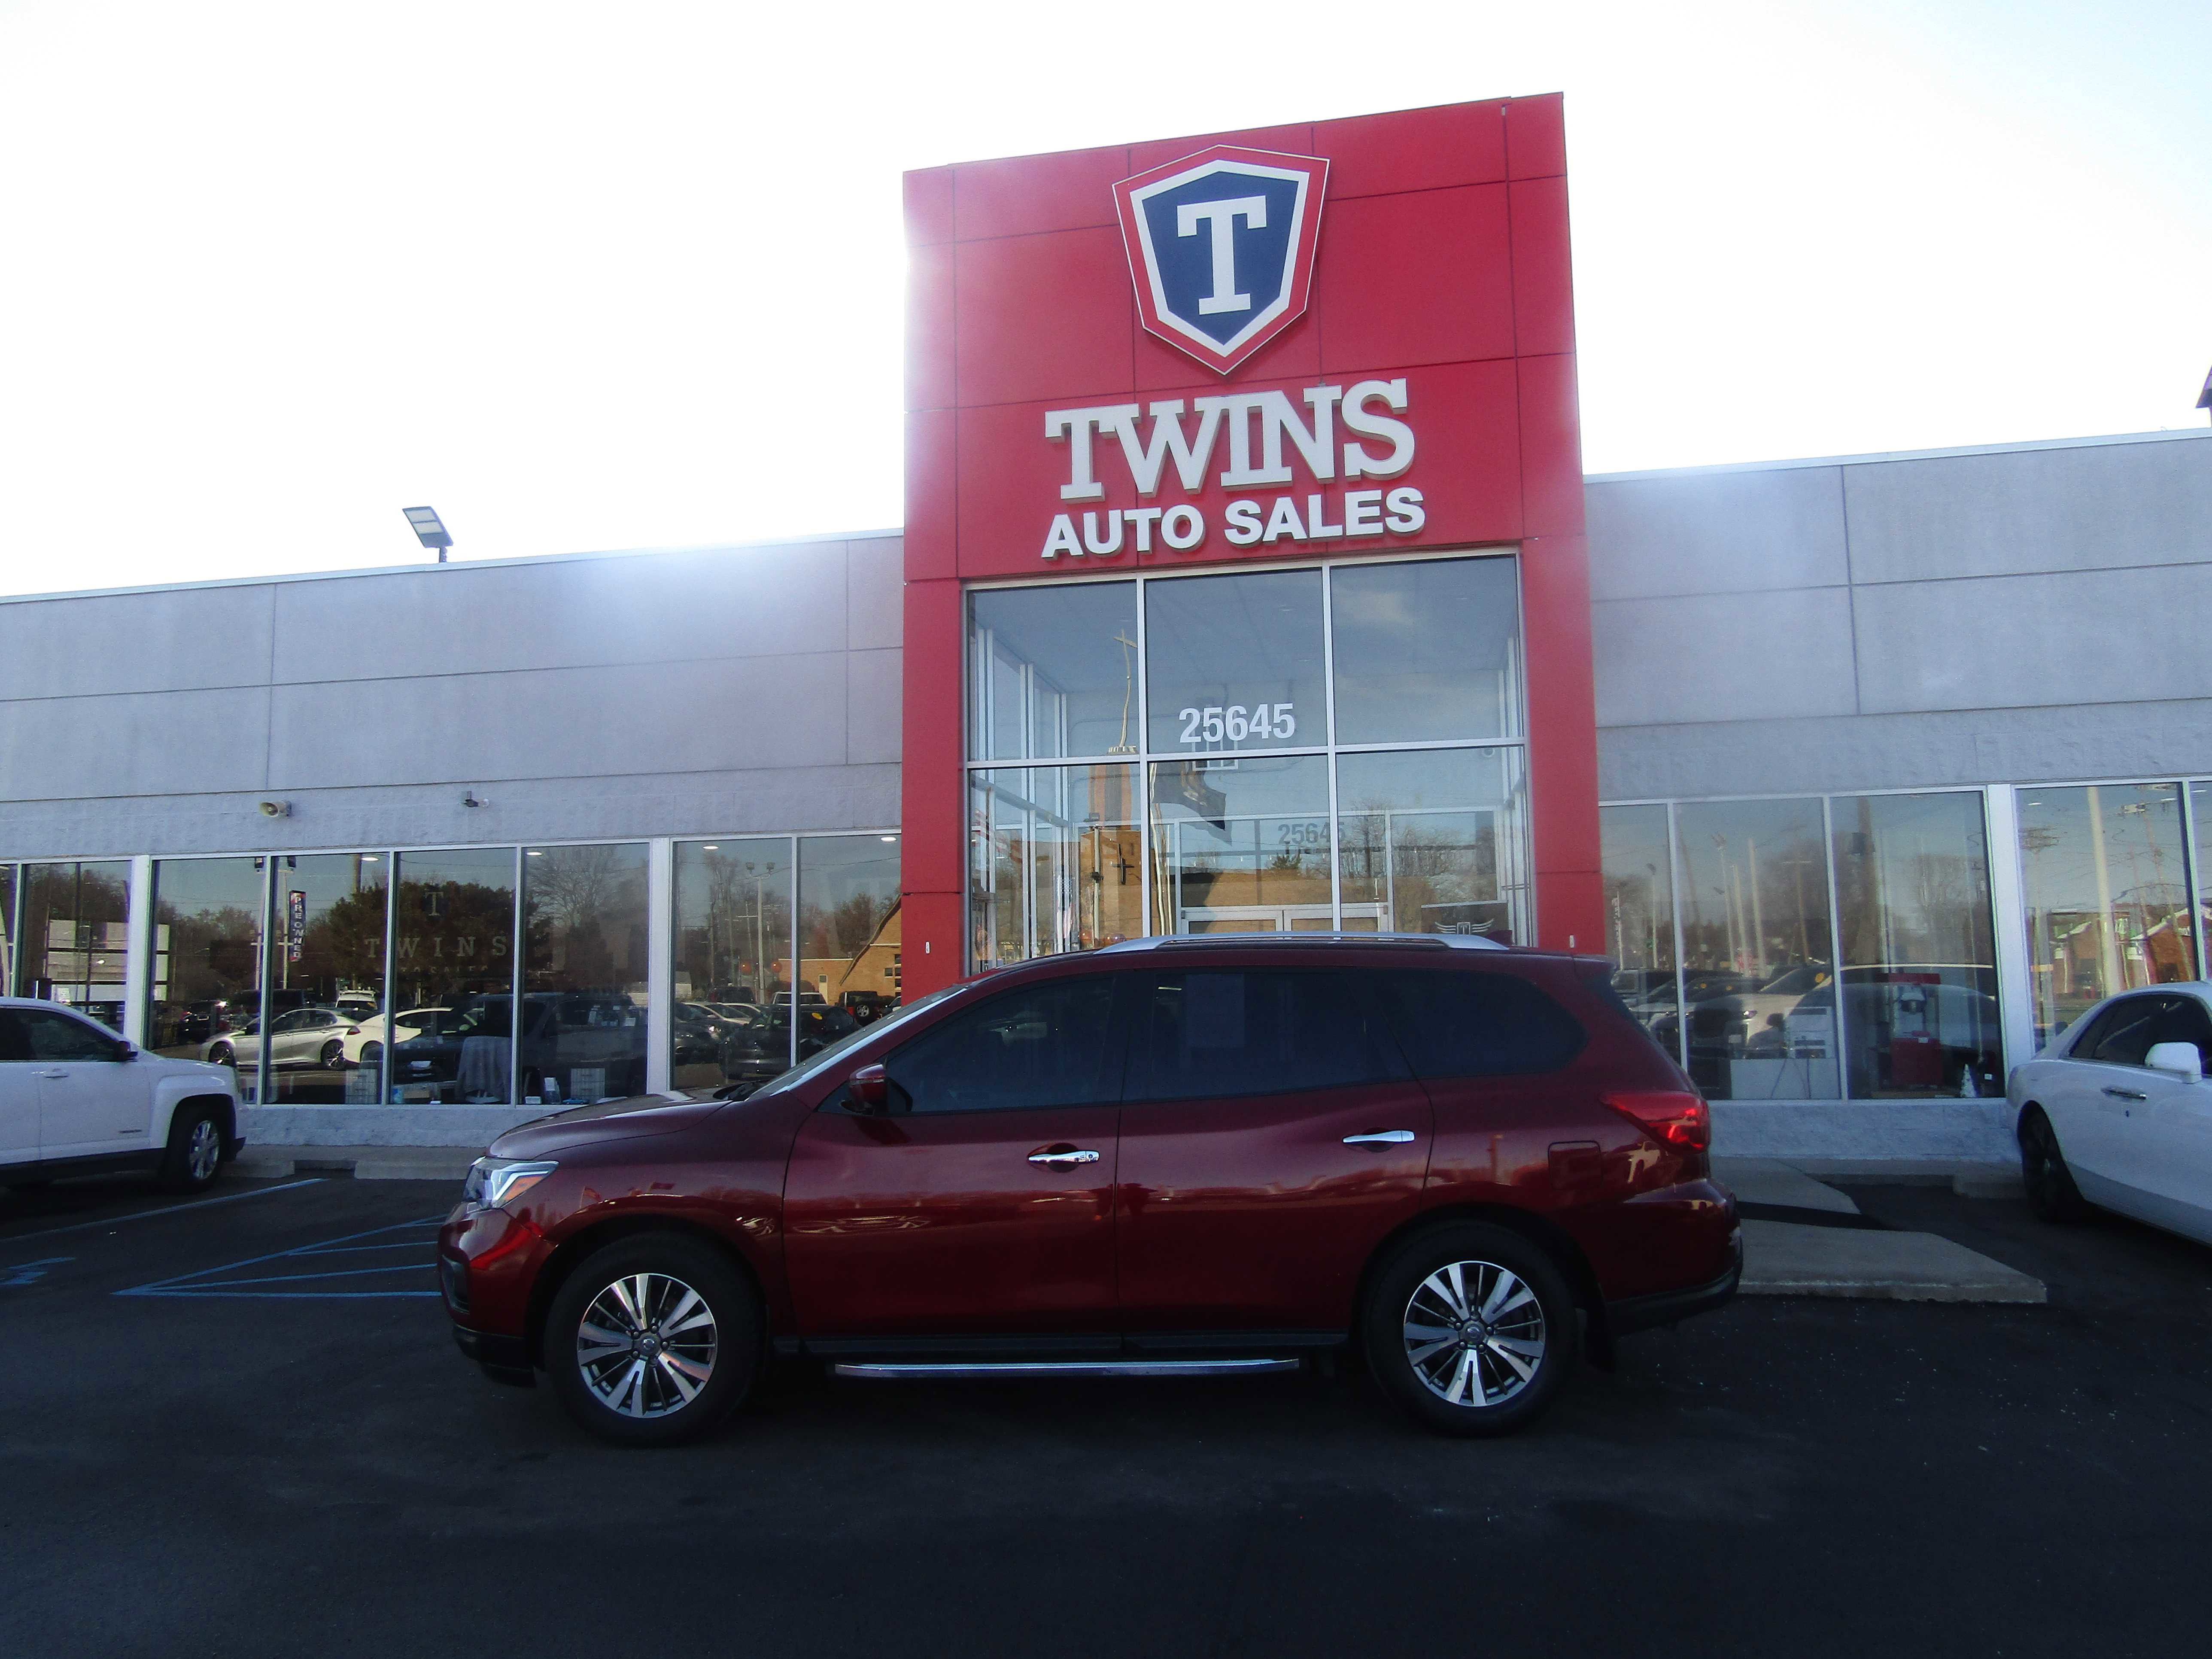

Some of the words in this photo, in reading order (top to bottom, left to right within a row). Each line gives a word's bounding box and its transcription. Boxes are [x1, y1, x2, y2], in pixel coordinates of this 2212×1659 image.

[1176, 195, 1267, 315] T
[1045, 378, 1415, 503] TWINS
[1041, 504, 1206, 560] AUTO
[1224, 486, 1425, 548] SALES
[1179, 703, 1295, 743] 25645
[425, 891, 444, 916] T
[365, 936, 508, 958] TWINS
